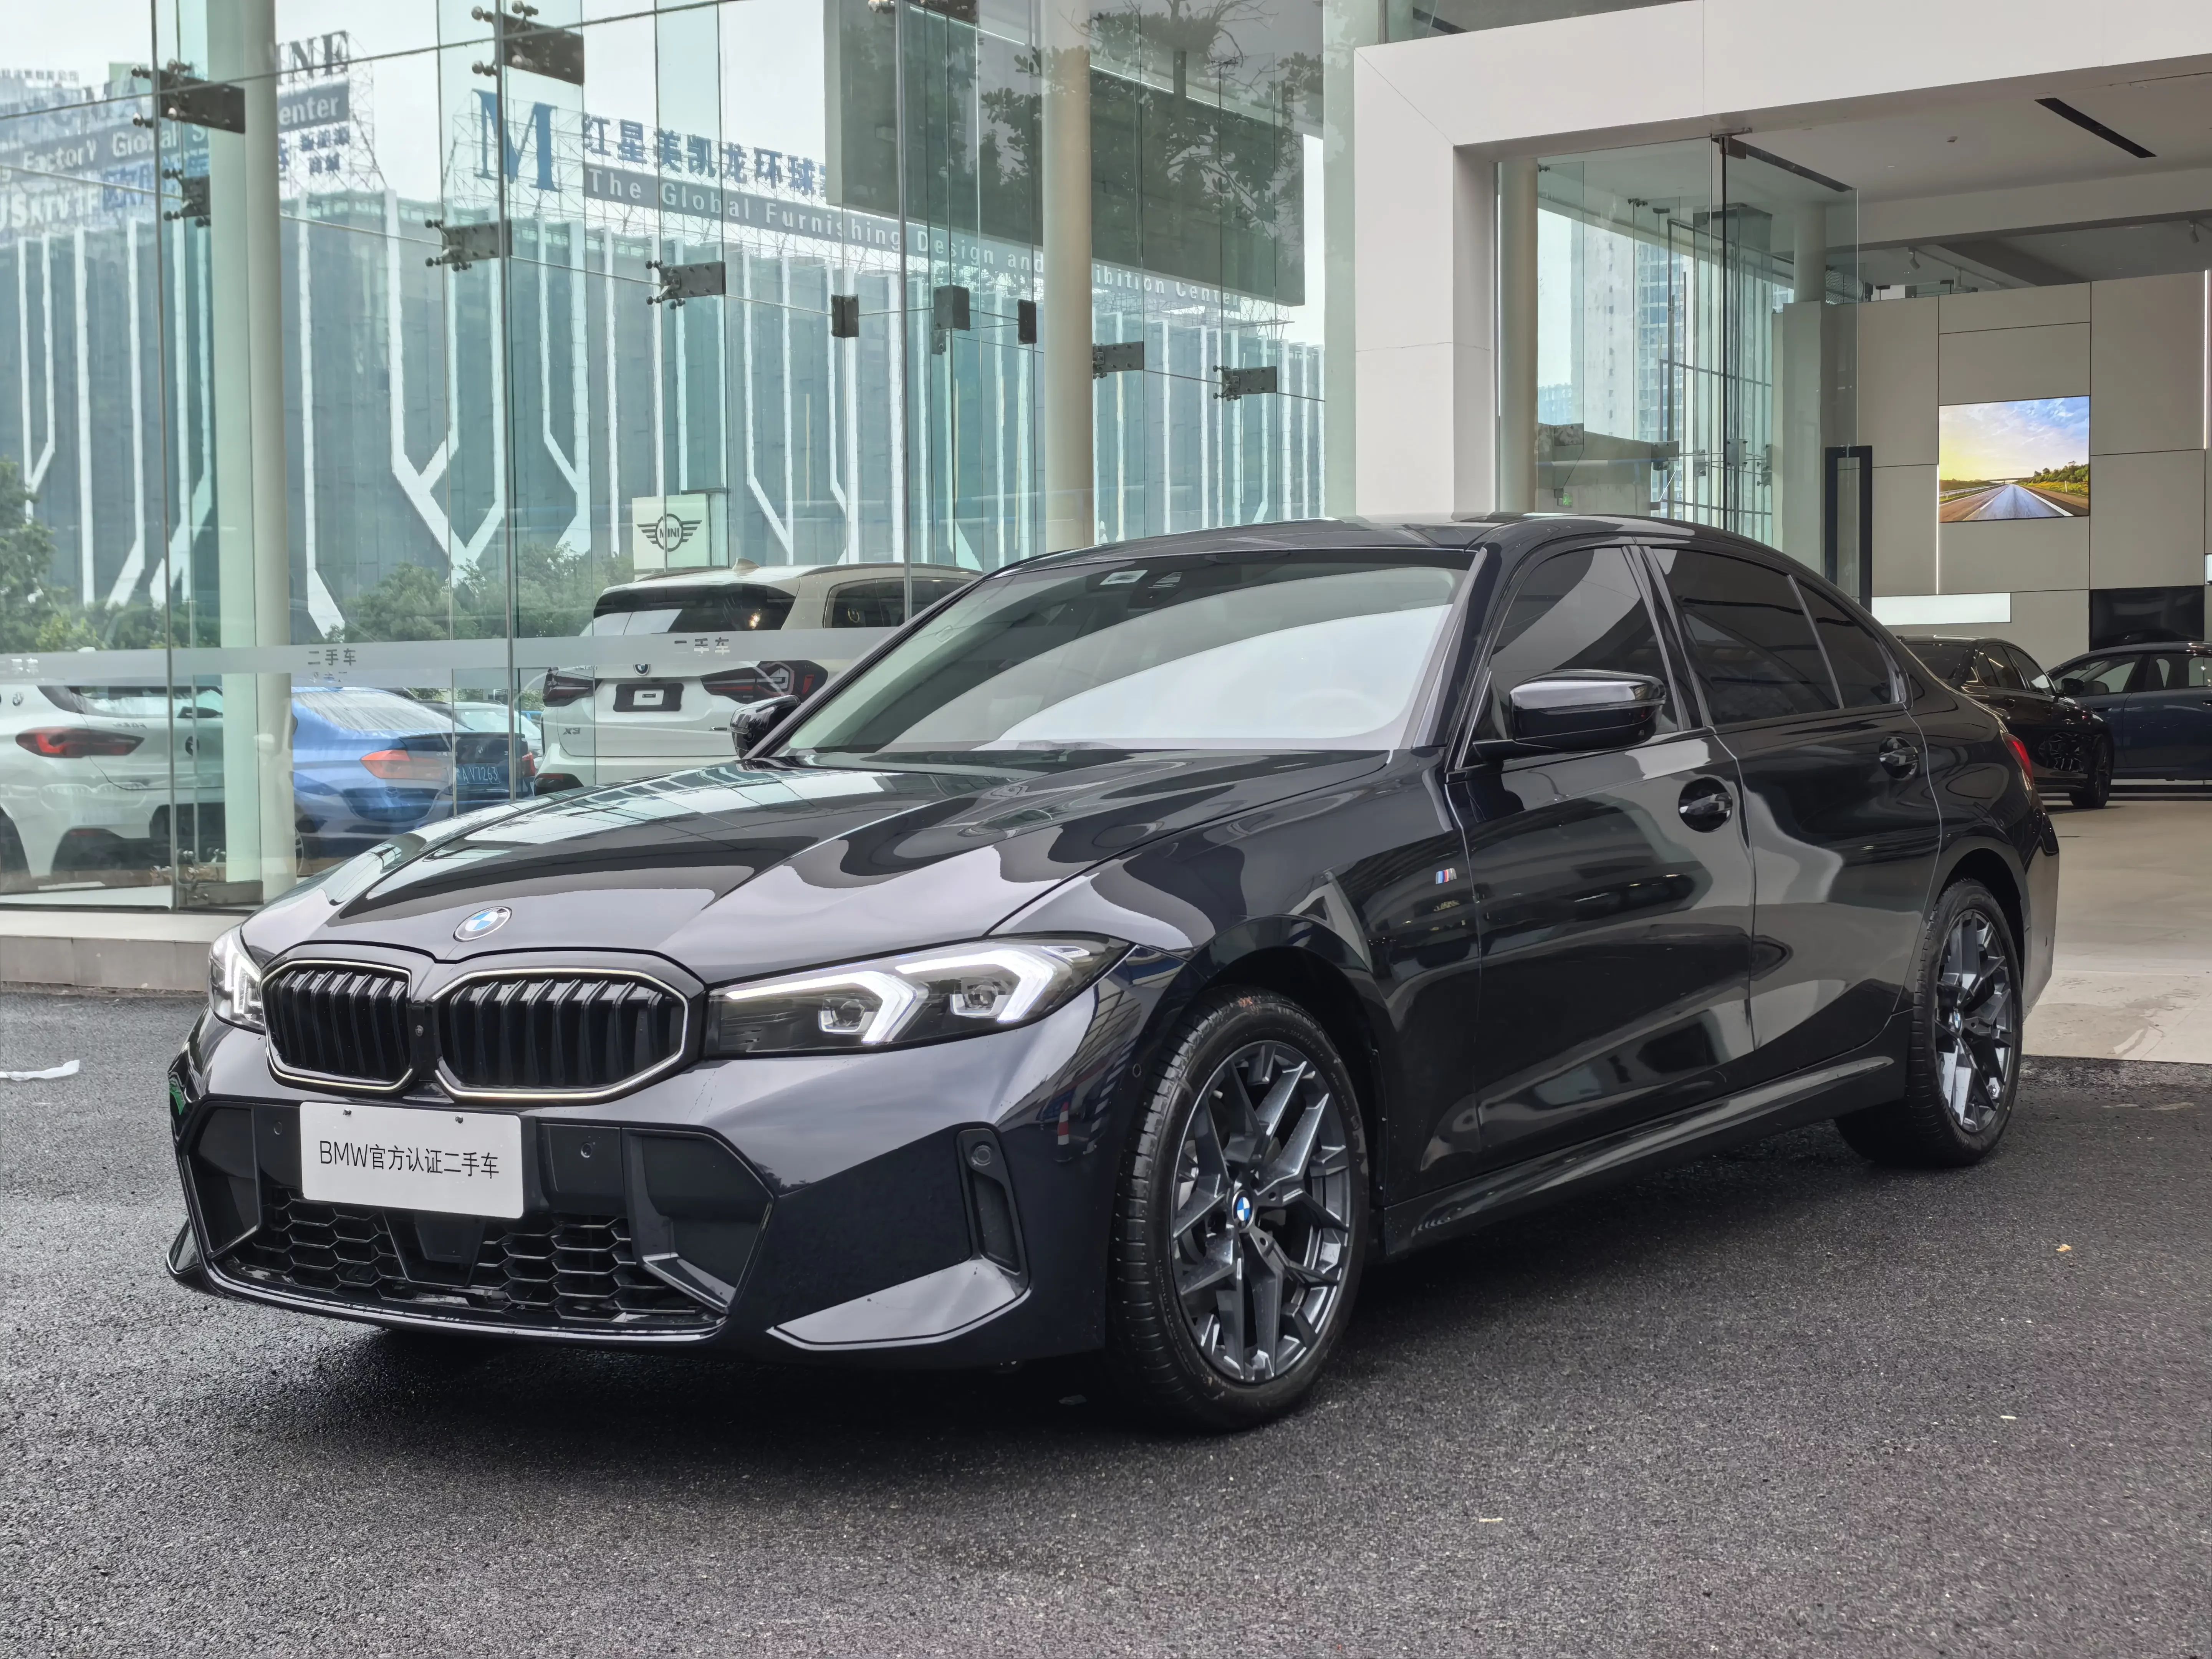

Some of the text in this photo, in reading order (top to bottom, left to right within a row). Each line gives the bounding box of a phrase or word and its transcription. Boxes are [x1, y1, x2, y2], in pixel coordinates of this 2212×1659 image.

[279, 96, 339, 126] enter
[471, 88, 563, 192] M
[582, 112, 826, 197] 红星美凯龙环球
[588, 168, 1240, 306] The Global Furnishing Design and ibition Center
[659, 528, 680, 538] MINI
[308, 648, 356, 666] 二手车
[674, 637, 730, 656] 二手车
[320, 1140, 499, 1179] BMW官方认证二手车
